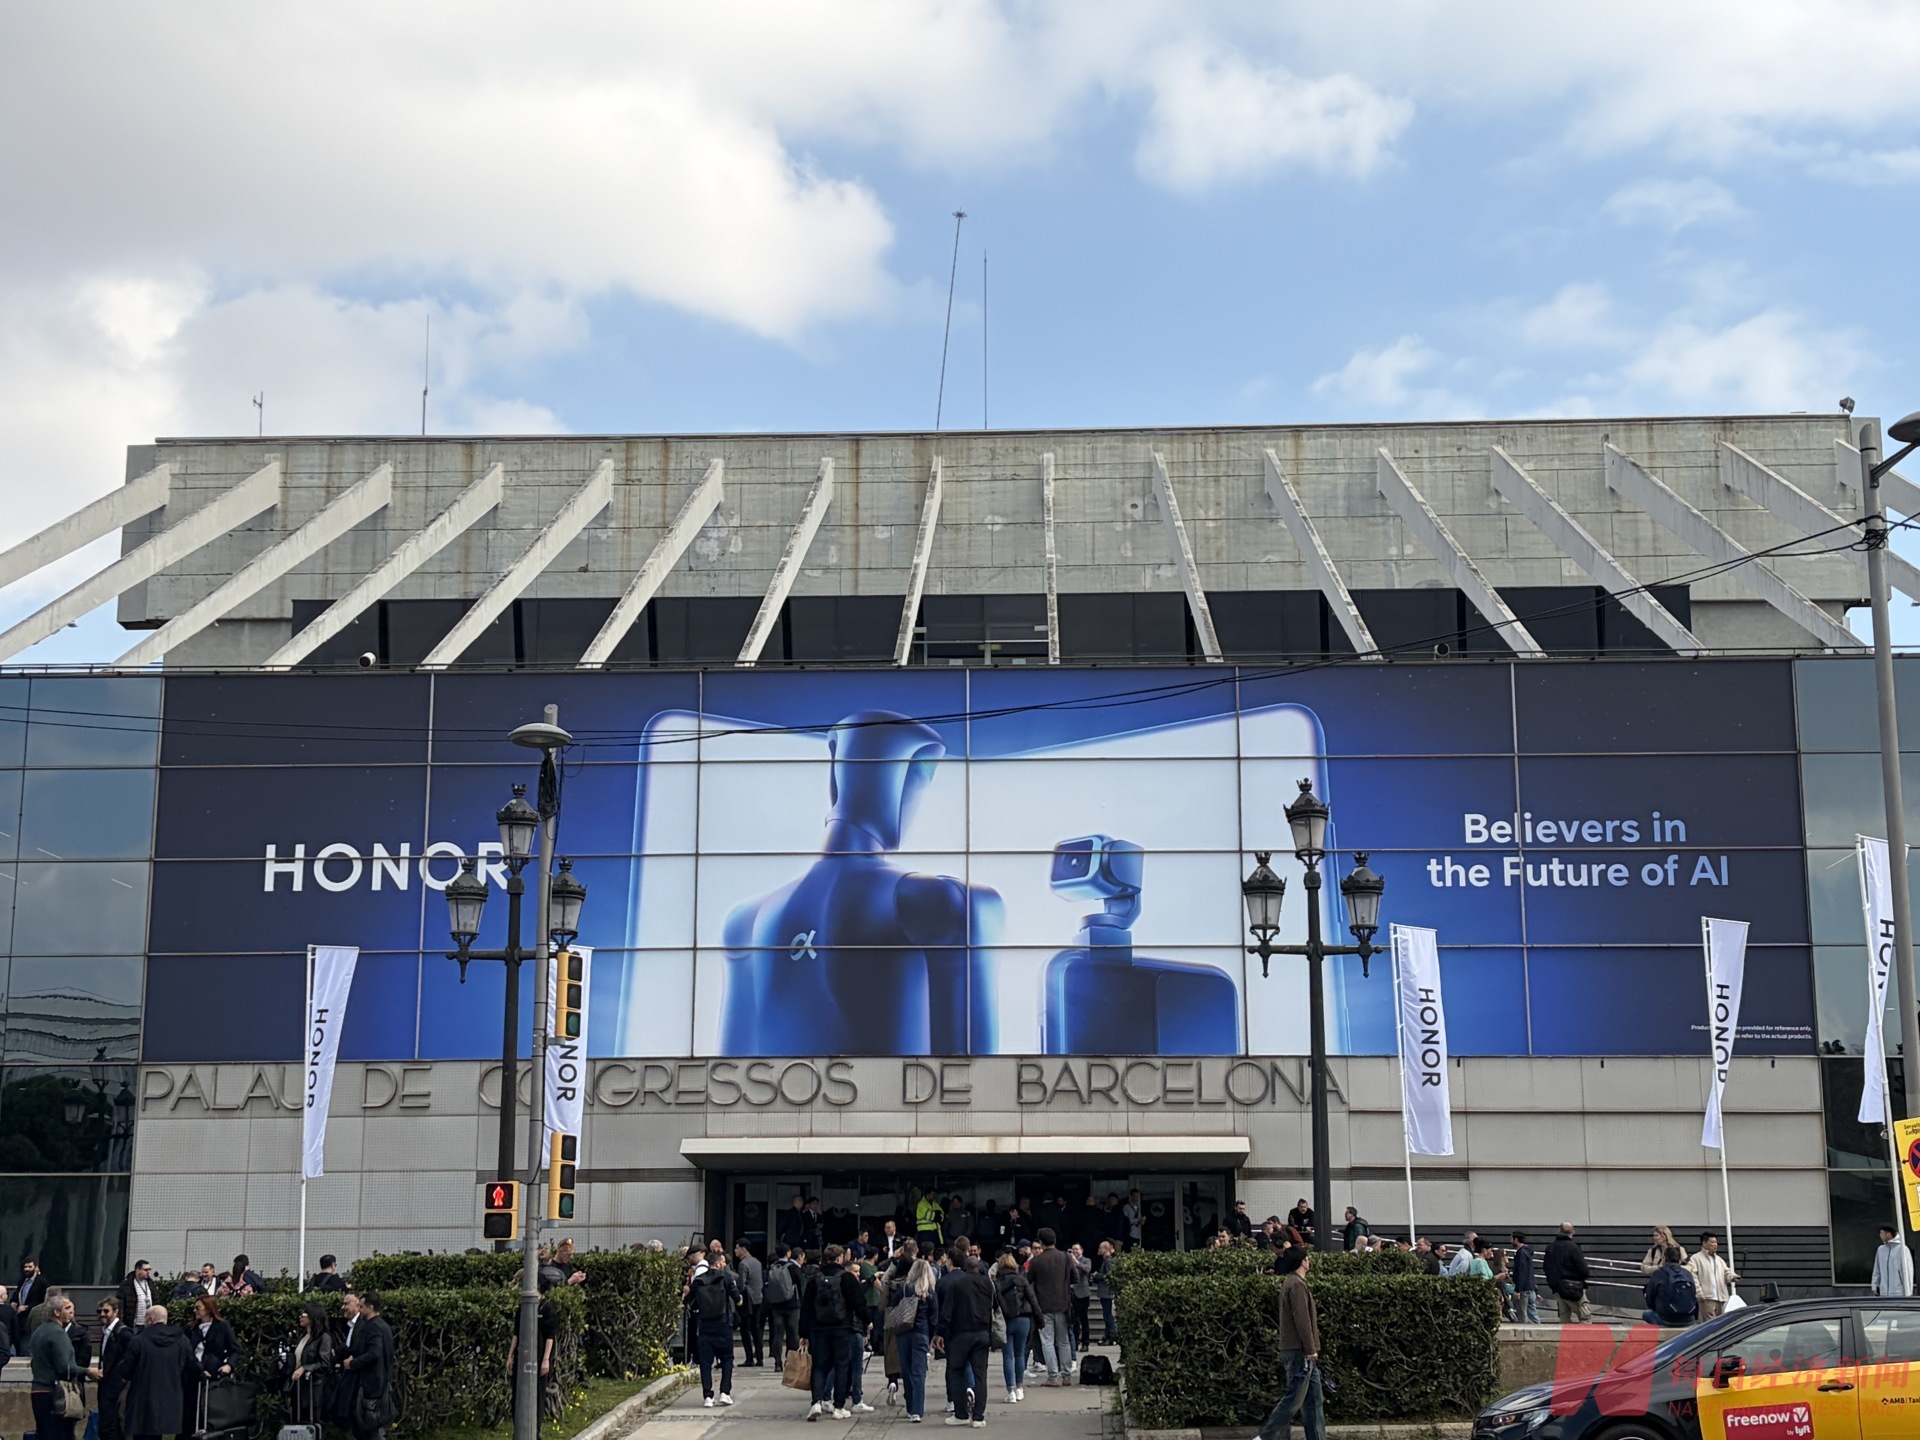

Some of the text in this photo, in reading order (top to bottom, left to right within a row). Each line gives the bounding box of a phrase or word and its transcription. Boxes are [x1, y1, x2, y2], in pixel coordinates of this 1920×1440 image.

[1464, 811, 1686, 844] Believers in
[264, 842, 508, 892] HONOR
[1427, 854, 1729, 887] the Future of AI
[307, 1008, 329, 1109] HONOR
[1418, 987, 1441, 1087] HONOR
[361, 1064, 432, 1109] DE
[479, 1061, 858, 1108] CGRESSOS
[902, 1059, 972, 1105] DE
[1016, 1059, 1347, 1105] BARCELONA
[1727, 1412, 1790, 1428] freenow
